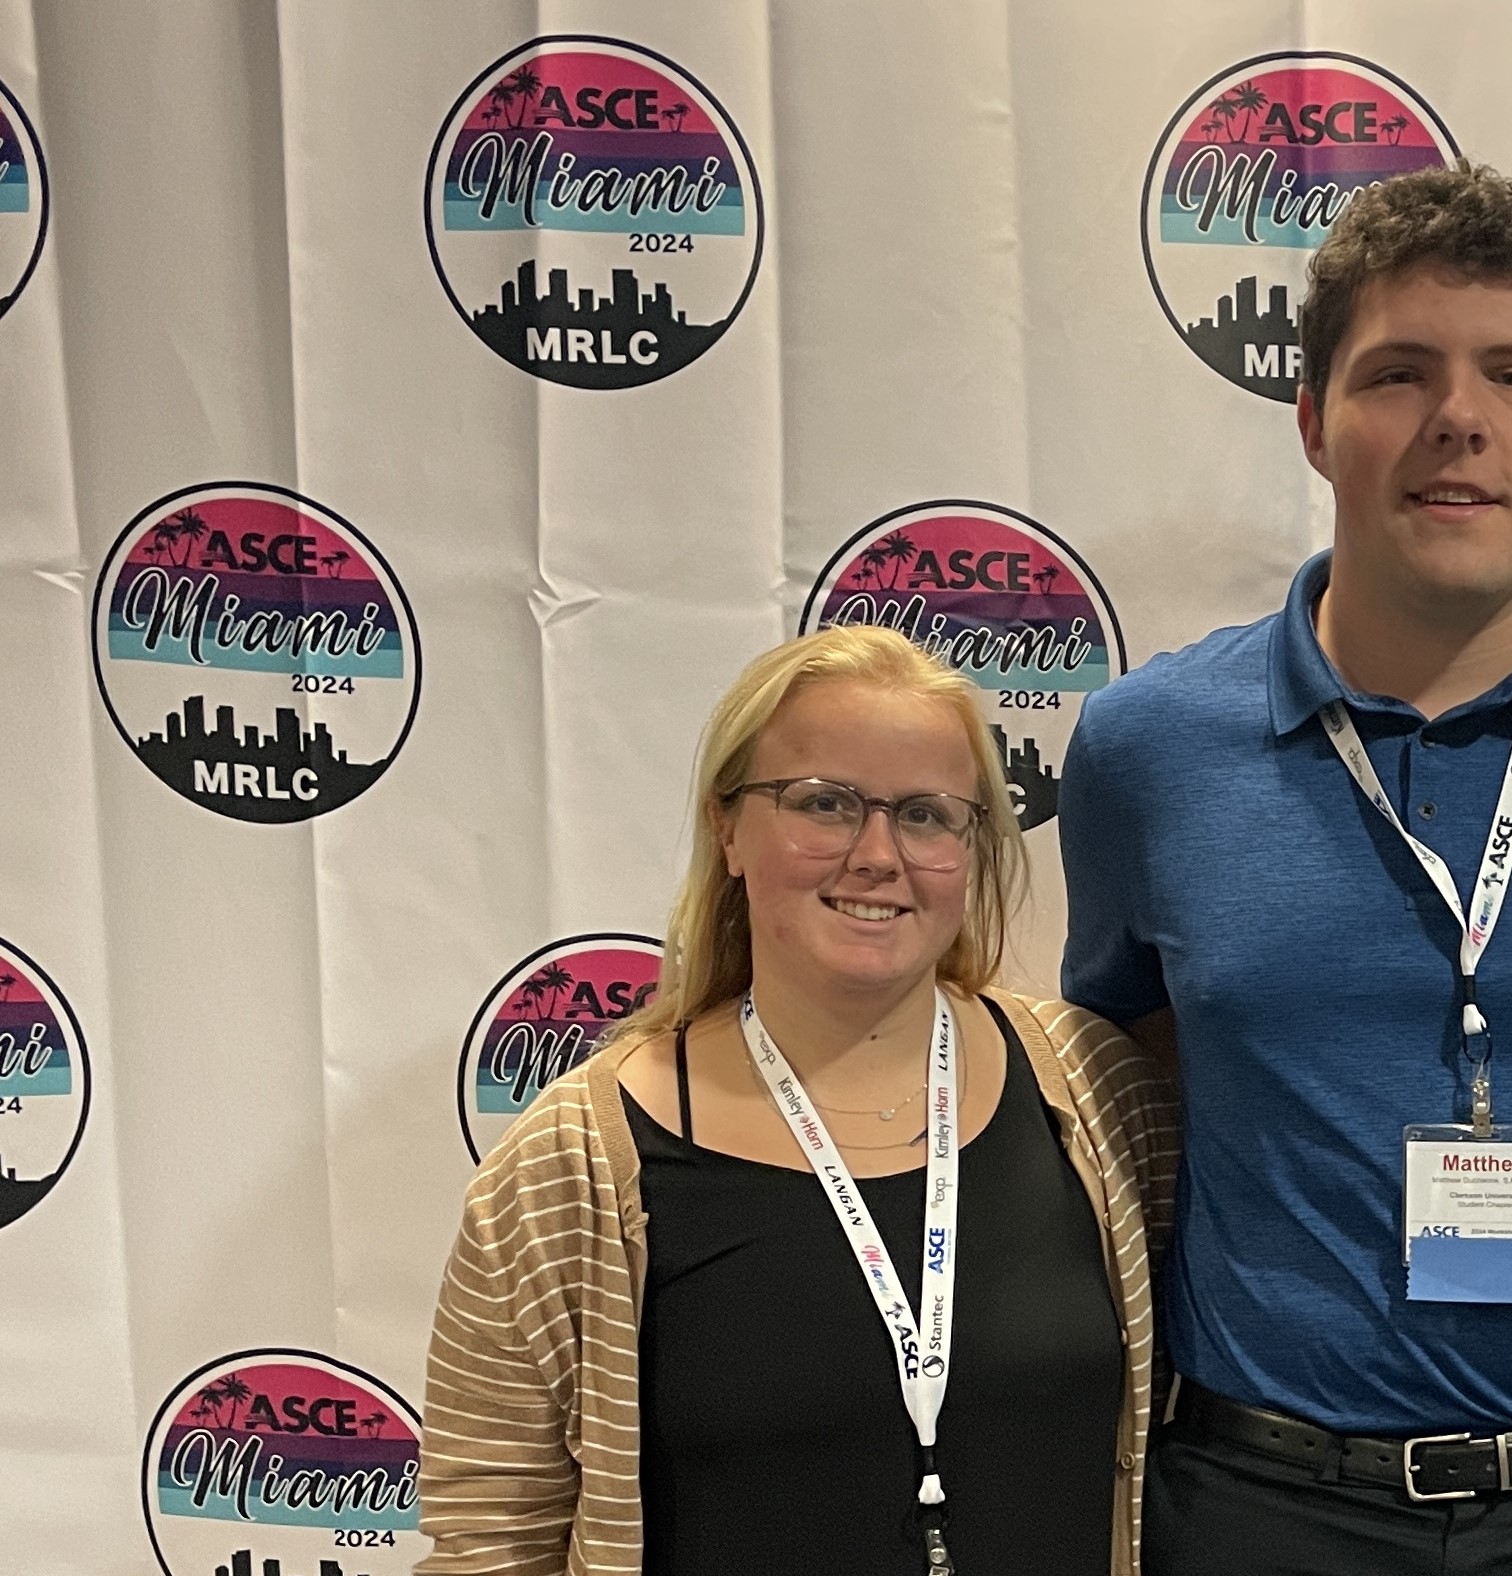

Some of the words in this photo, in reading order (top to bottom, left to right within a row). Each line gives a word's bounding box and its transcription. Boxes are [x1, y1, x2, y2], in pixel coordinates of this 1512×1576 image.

[535, 87, 659, 129] ASCE
[1258, 102, 1377, 144] ASCE
[458, 130, 725, 227] Miami
[1176, 145, 1380, 245] Mia
[628, 232, 695, 254] 2024
[526, 328, 660, 367] MRLC
[199, 529, 319, 575] ASCE
[907, 550, 1031, 591] ASCE
[122, 566, 386, 665] Miami
[291, 673, 355, 695] 2024
[999, 690, 1061, 710] 2024
[193, 761, 320, 801] MRLC
[938, 1011, 951, 1071] LANGAN
[778, 1076, 804, 1115] Kimley
[802, 1122, 824, 1150] Horn
[937, 1086, 949, 1121] Horn
[935, 1121, 954, 1159] Kimley
[824, 1165, 865, 1227] LANGAN
[935, 1176, 953, 1203] exp
[928, 1227, 945, 1274] ASCE
[1421, 1226, 1460, 1238] ASCE
[929, 1295, 944, 1351] Stantec
[895, 1324, 918, 1380] ASCE
[243, 1394, 359, 1436] ASCE
[170, 1429, 421, 1521] Miami
[333, 1527, 396, 1548] 2024
